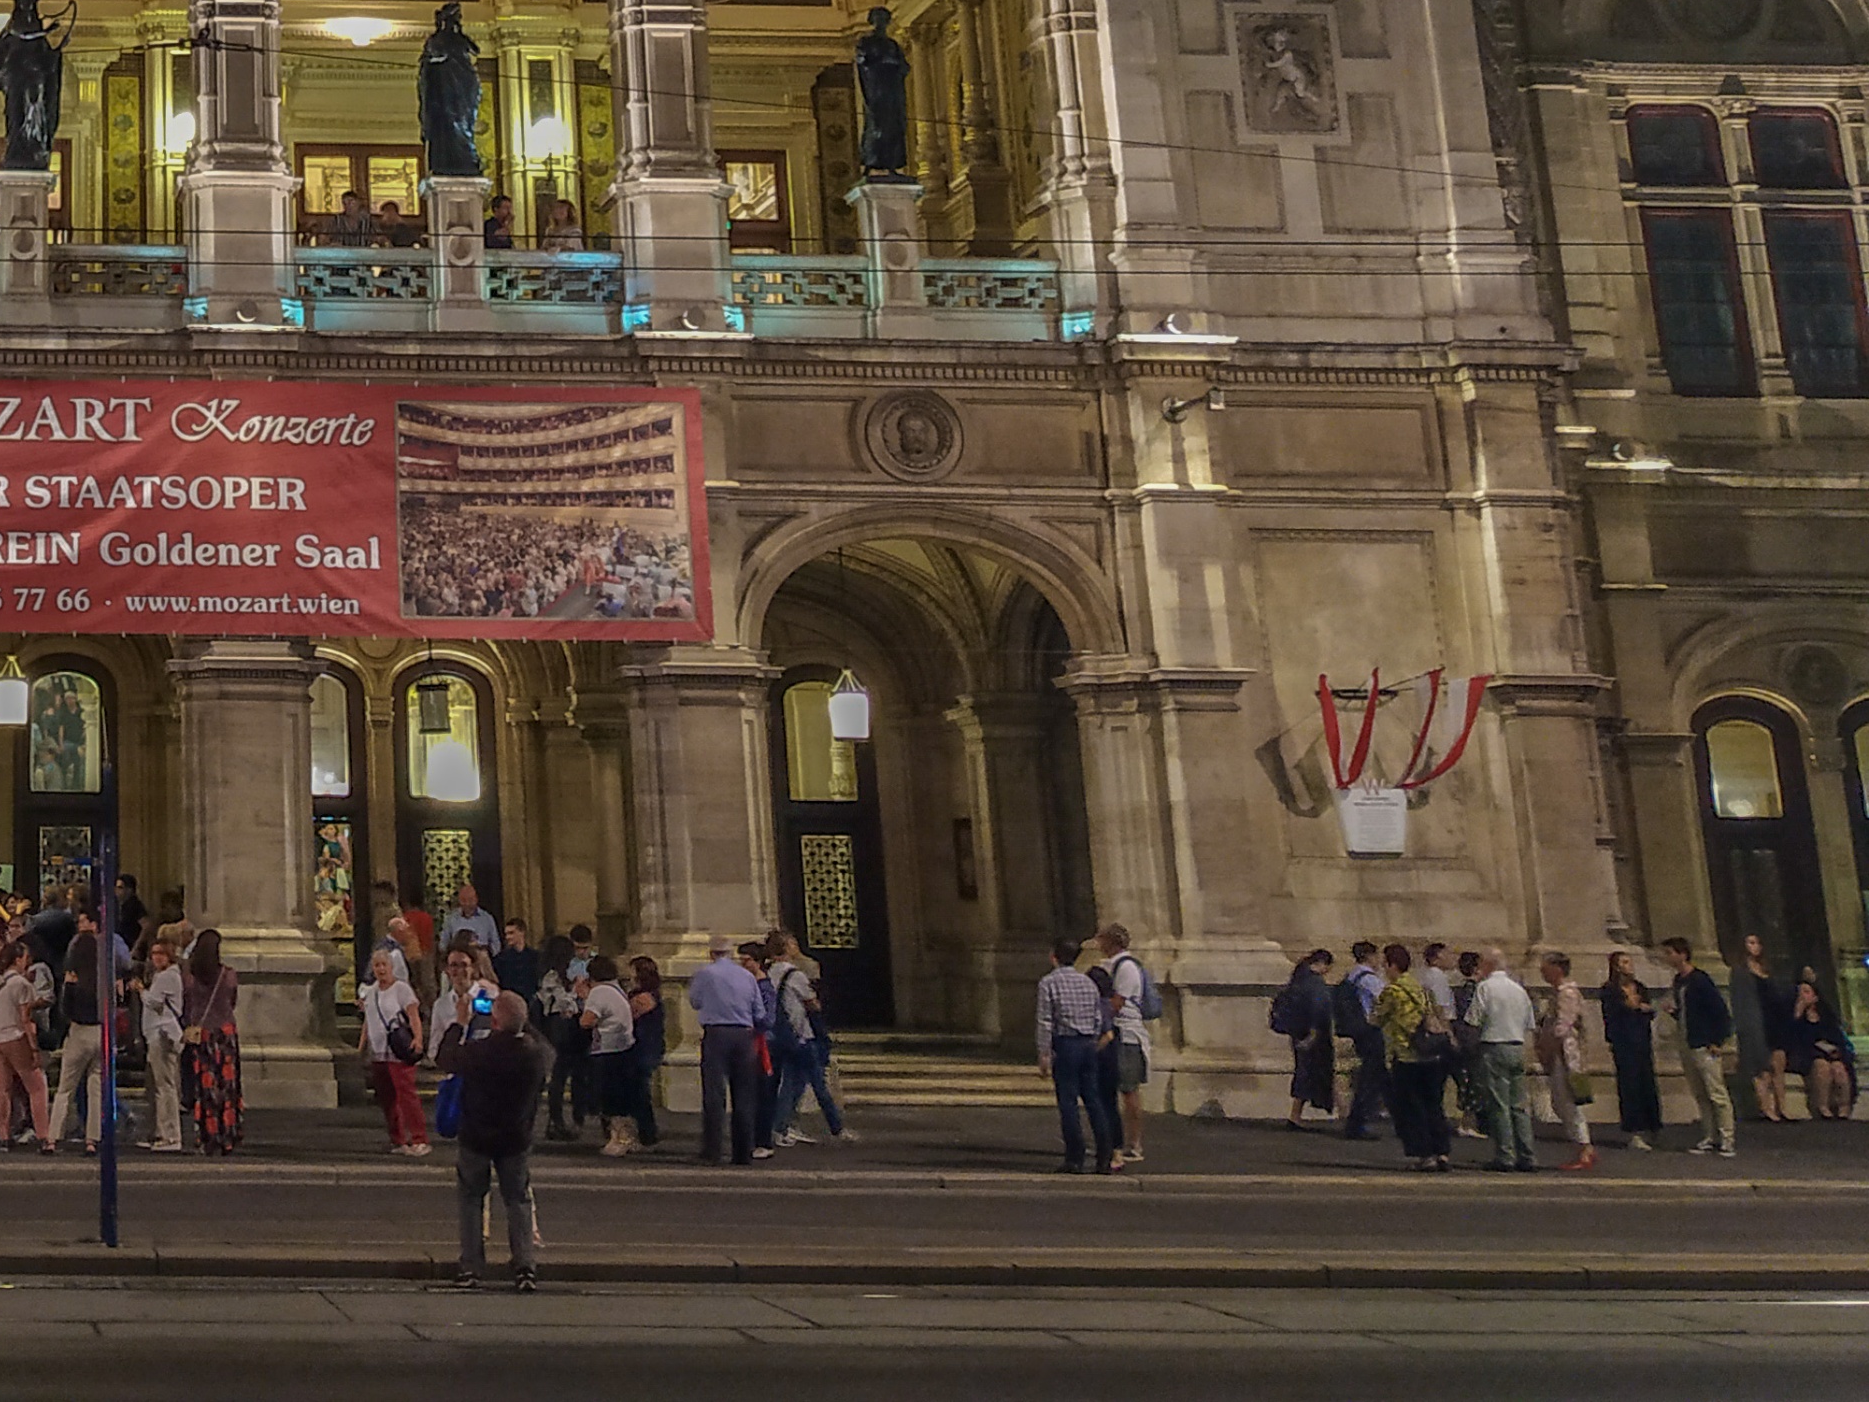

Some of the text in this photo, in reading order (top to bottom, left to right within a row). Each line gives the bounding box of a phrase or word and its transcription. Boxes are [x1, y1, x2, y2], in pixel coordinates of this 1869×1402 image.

[170, 398, 375, 446] Konzerte
[24, 475, 308, 511] STAATSOPER
[98, 532, 281, 567] Goldener
[294, 534, 382, 570] Saal
[13, 588, 46, 611] 77
[56, 589, 91, 612] 66
[124, 592, 361, 616] www.mozart.wien
